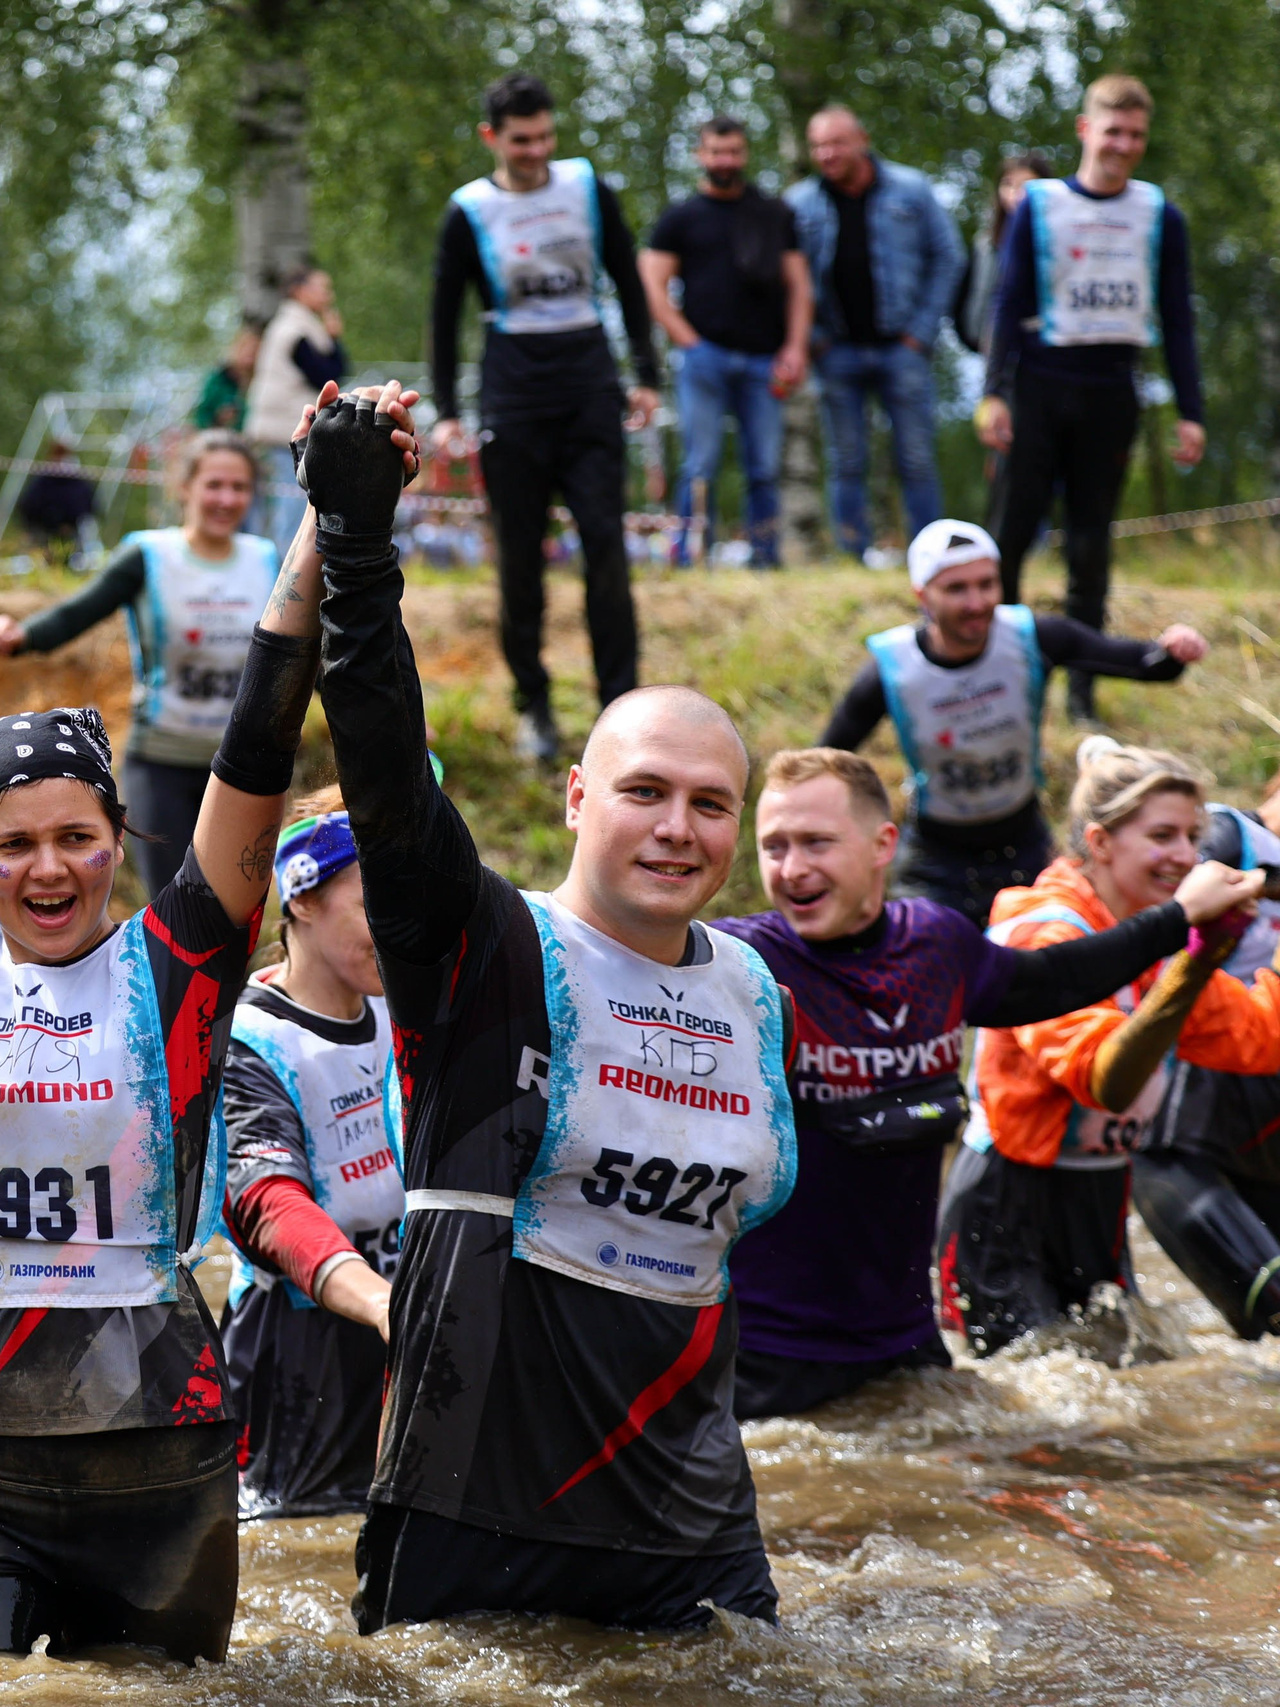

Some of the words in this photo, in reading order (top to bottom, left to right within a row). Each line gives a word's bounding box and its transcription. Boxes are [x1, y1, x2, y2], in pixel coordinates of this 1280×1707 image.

[21, 1006, 93, 1032] ГЕРОЕВ
[608, 999, 671, 1023] ГОНКА
[676, 1009, 733, 1038] ГЕРОЕВ
[640, 1029, 718, 1077] КГБ
[330, 1086, 375, 1112] ГОНКА
[580, 1147, 748, 1230] 5927
[9, 1263, 96, 1279] ГАЗПРОМБАНК
[625, 1251, 697, 1278] ГАЗПРОМБАНК
